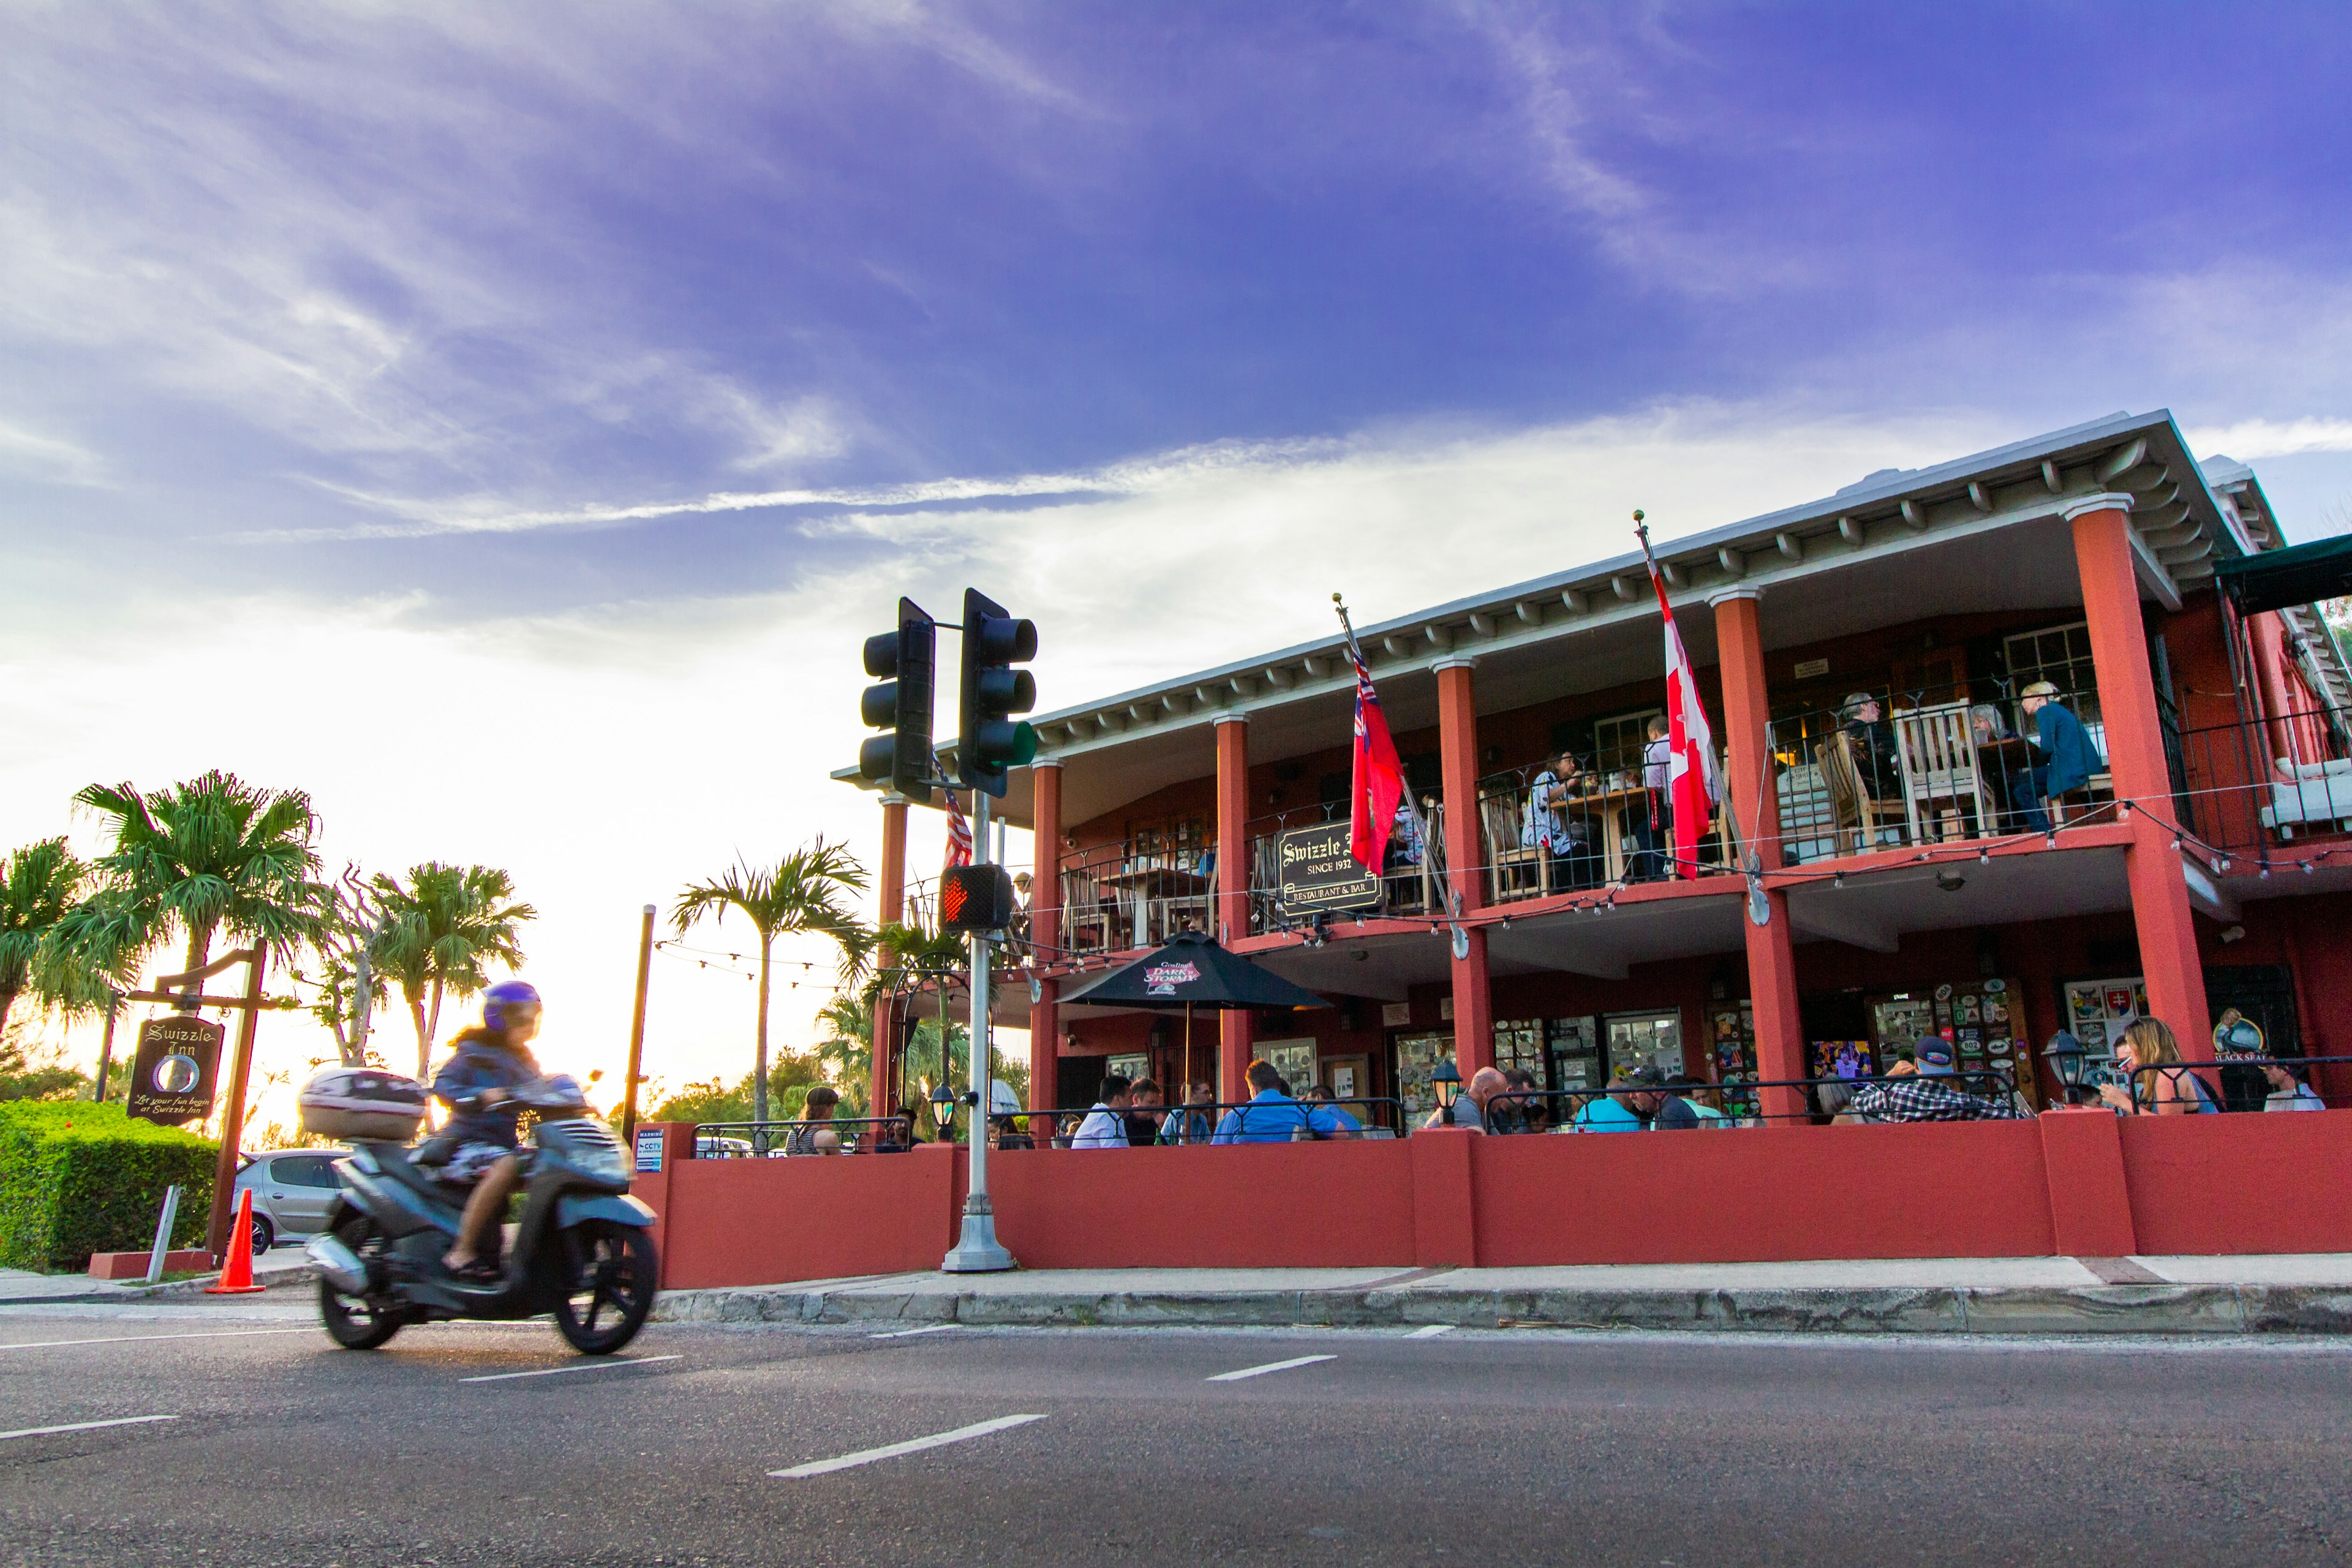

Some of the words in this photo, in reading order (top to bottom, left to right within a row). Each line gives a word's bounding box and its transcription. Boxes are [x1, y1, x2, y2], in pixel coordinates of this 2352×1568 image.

[1283, 836, 1341, 867] Swizzle
[1307, 862, 1333, 875] SINCE
[1335, 859, 1352, 870] 1932
[1294, 887, 1340, 901] RESTAURANT
[1341, 886, 1349, 894] &
[1351, 883, 1366, 892] BAR
[1144, 974, 1193, 982] STORMY
[146, 1025, 216, 1042] Swizzle
[168, 1041, 195, 1056] Inn
[135, 1095, 149, 1105] Let
[172, 1097, 187, 1106] fun
[189, 1097, 209, 1107] begin
[153, 1106, 186, 1114] Swizzle
